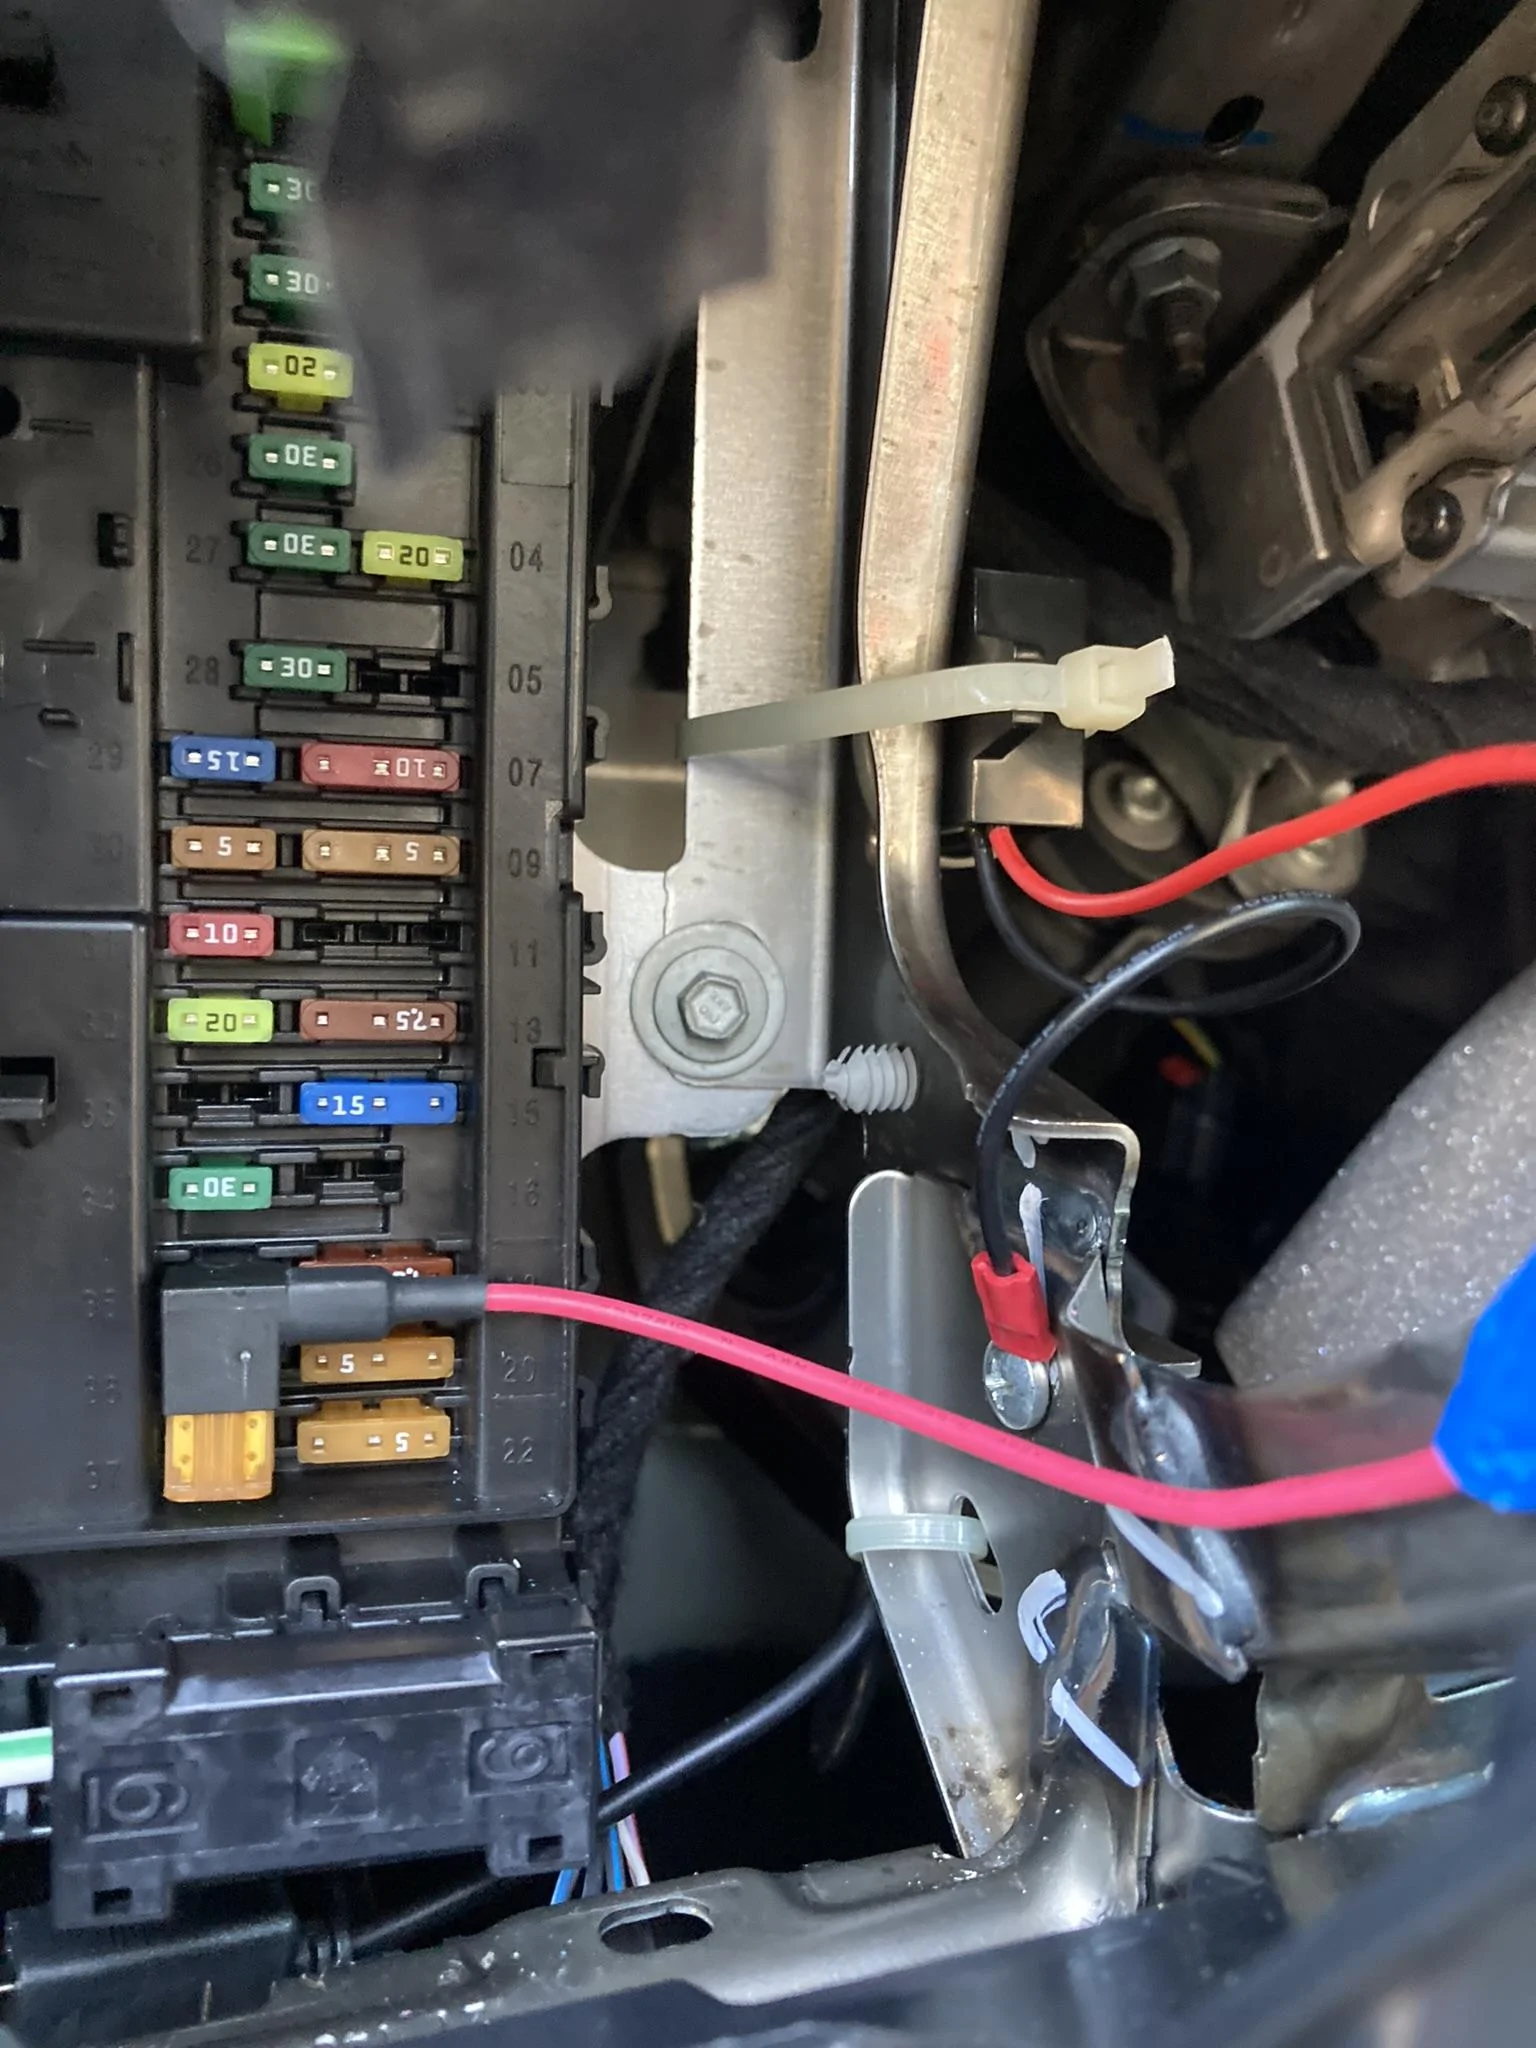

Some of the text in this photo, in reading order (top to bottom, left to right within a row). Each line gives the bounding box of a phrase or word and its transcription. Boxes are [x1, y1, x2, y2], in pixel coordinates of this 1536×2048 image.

[287, 270, 321, 295] 30
[284, 356, 318, 377] 20
[284, 445, 318, 467] 30
[186, 534, 218, 563] 27
[283, 533, 316, 556] 30
[399, 546, 430, 569] 20
[510, 543, 543, 572] 04
[186, 655, 219, 686] 28
[281, 657, 313, 679] 30
[509, 664, 542, 694] 05
[509, 758, 542, 786] 07
[217, 837, 232, 857] 5
[405, 841, 419, 862] 5
[509, 848, 541, 878] 09
[204, 923, 238, 945] 10
[510, 940, 540, 967] 11
[205, 1012, 237, 1034] 20
[510, 1015, 542, 1043] 13
[331, 1094, 364, 1116] 15
[203, 1176, 236, 1198] 30
[339, 1353, 355, 1374] 5
[395, 1431, 410, 1453] 5
[502, 1437, 534, 1464] 22
